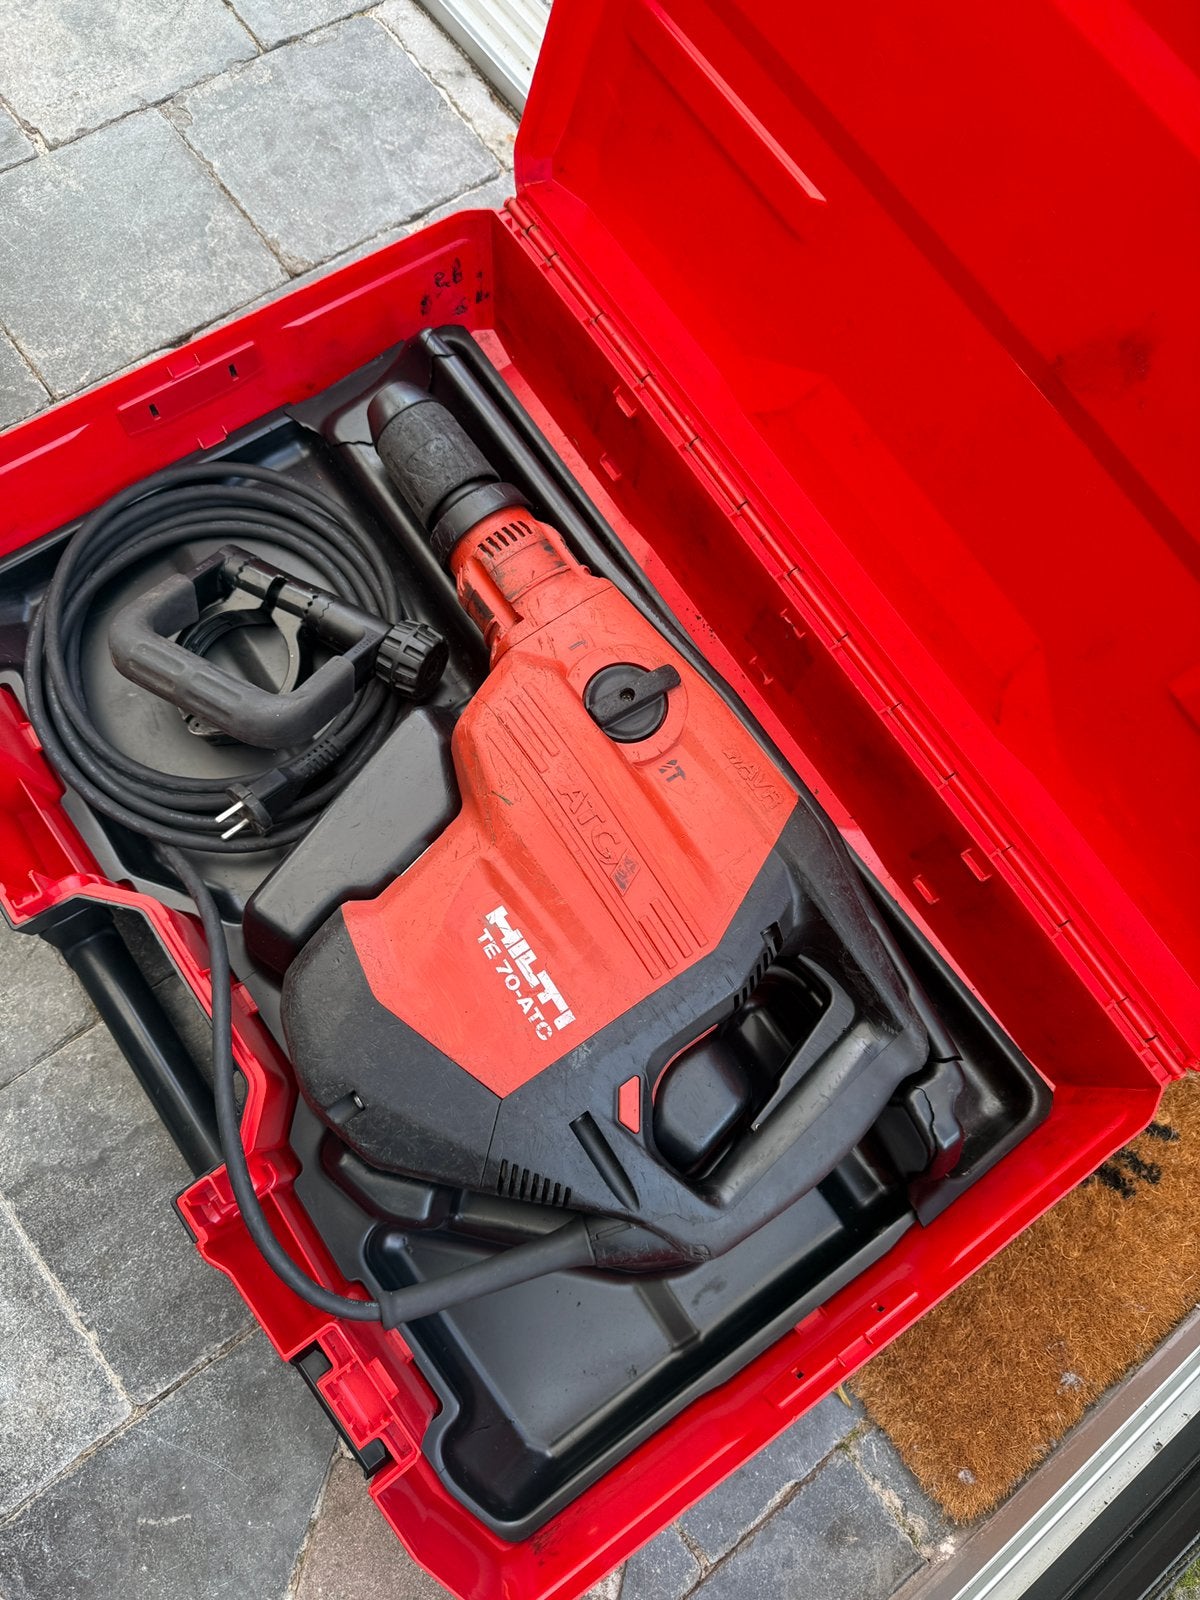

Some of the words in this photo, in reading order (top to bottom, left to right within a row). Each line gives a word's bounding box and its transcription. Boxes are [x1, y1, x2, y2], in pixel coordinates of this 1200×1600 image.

[557, 788, 622, 866] ATC
[477, 927, 502, 960] TE
[496, 958, 553, 1041] 70-ATC
[485, 905, 576, 1031] HILTI
